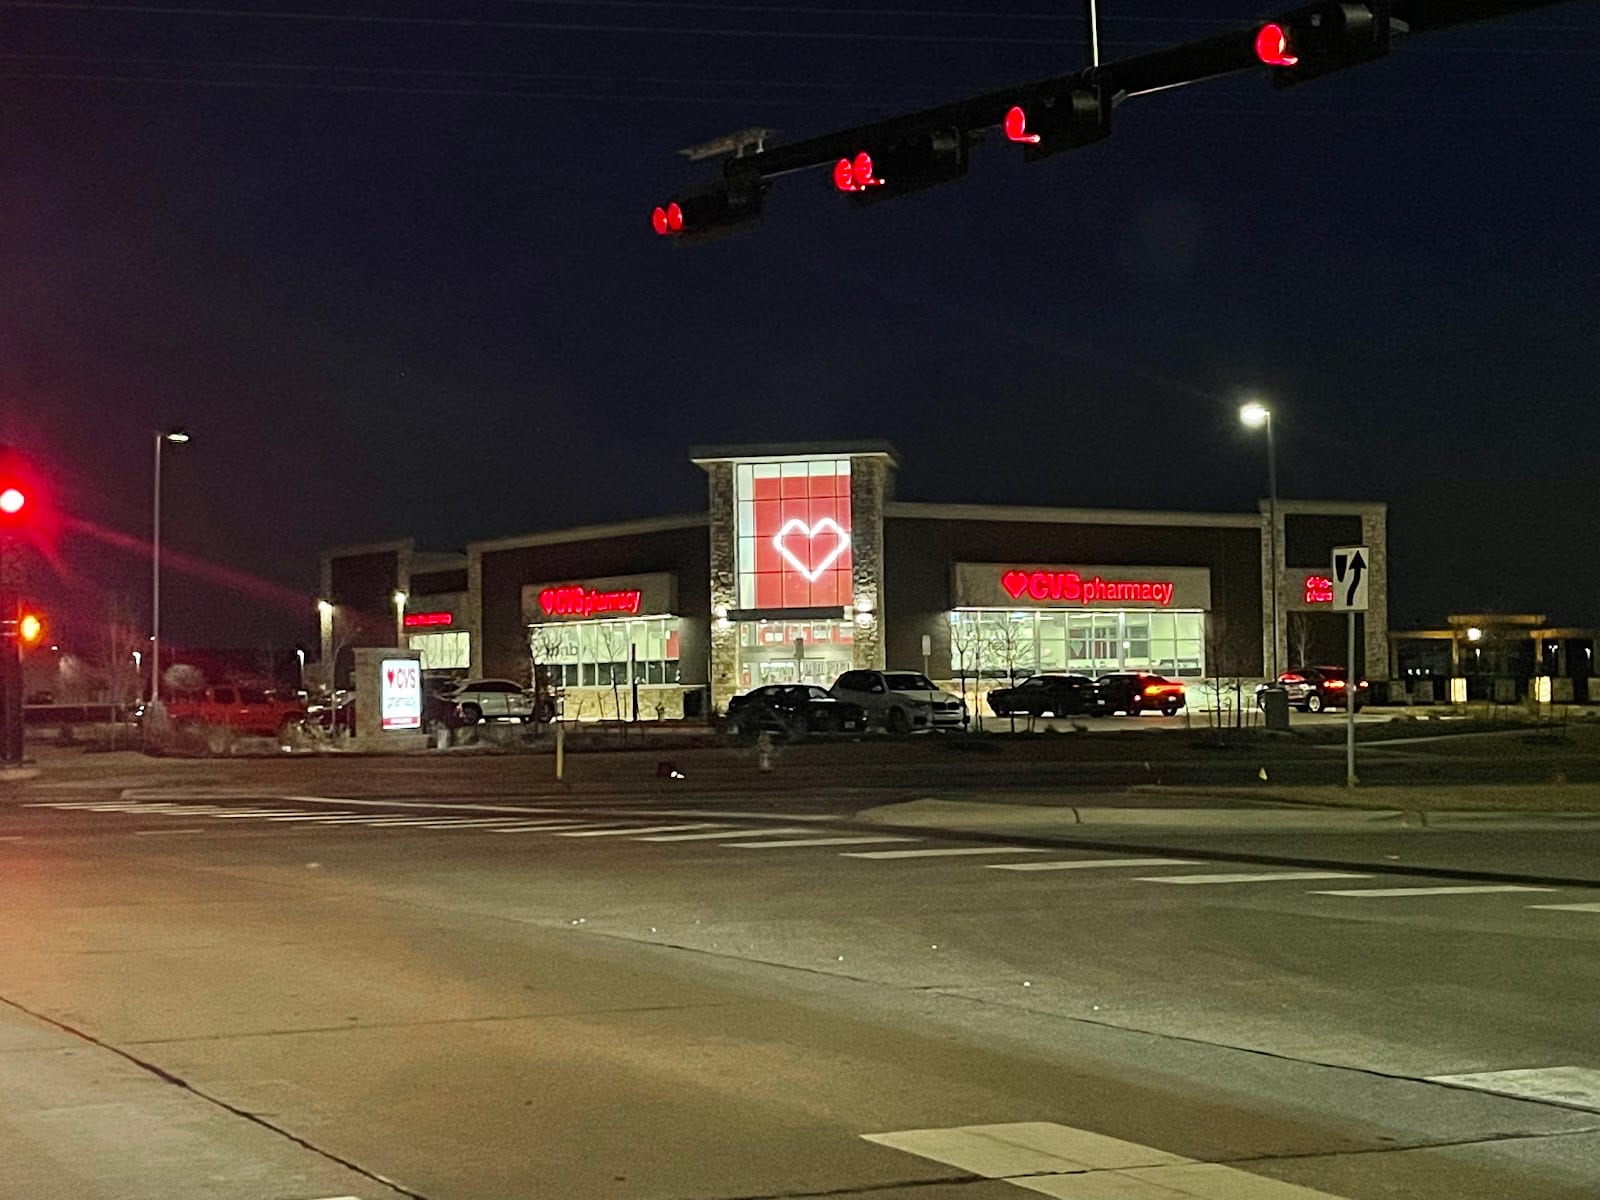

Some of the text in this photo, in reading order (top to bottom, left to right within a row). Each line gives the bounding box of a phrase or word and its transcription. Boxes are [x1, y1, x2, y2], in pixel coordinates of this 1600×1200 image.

[557, 586, 585, 614] CVS
[1028, 572, 1174, 605] CVS pharmacy
[396, 667, 416, 689] CVS
